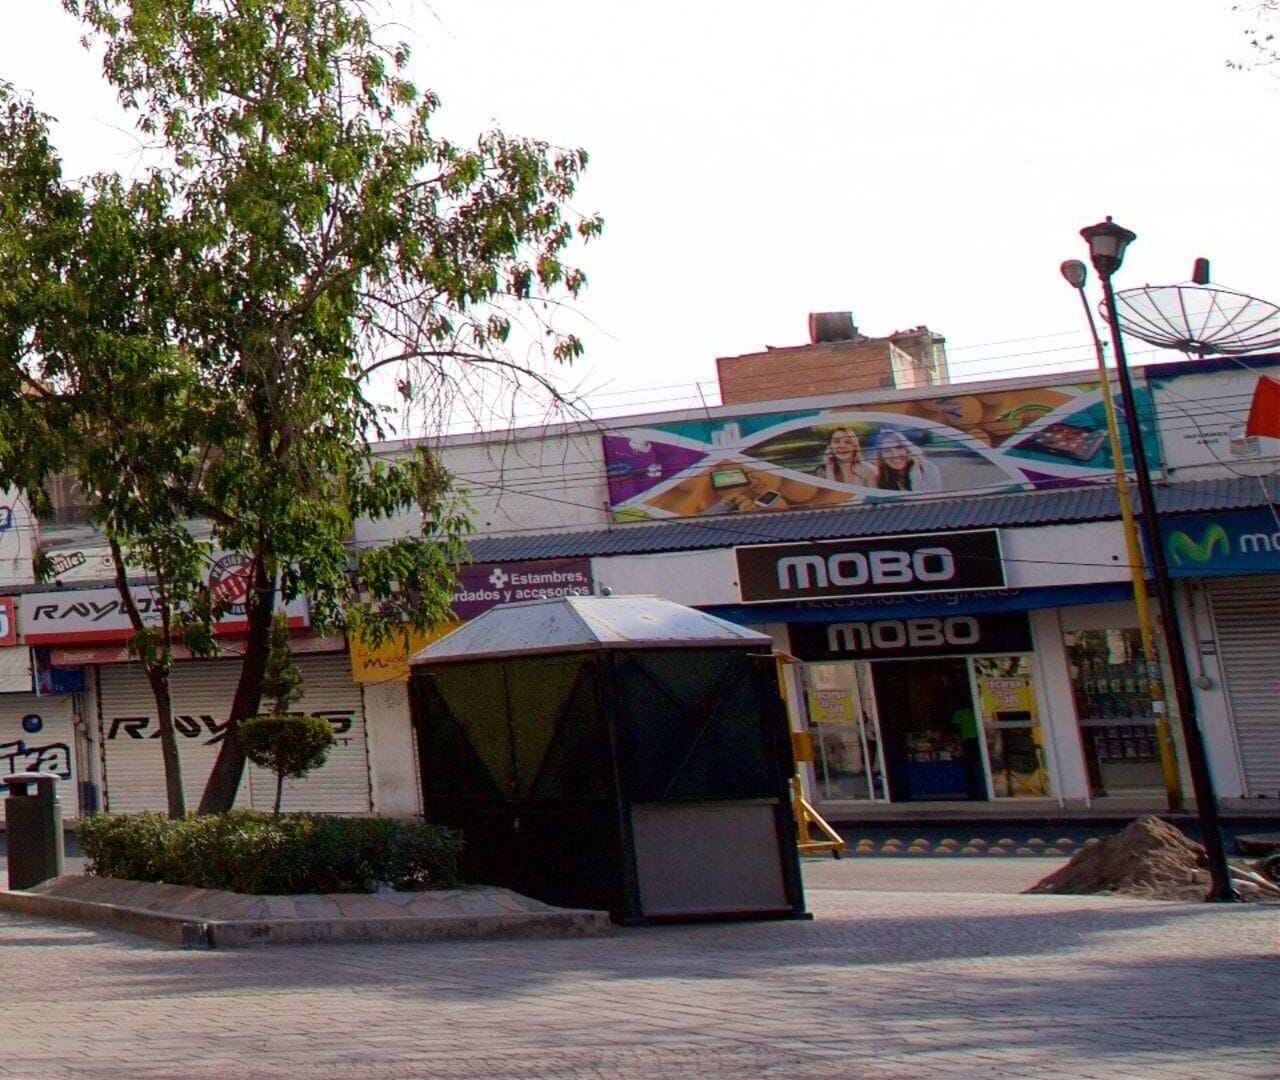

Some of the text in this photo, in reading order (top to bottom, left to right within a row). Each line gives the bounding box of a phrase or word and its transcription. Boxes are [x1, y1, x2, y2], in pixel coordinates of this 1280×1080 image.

[510, 570, 588, 585] Estambres,
[503, 589, 512, 602] y
[515, 583, 590, 600] accesorios
[63, 651, 96, 663] Reebok
